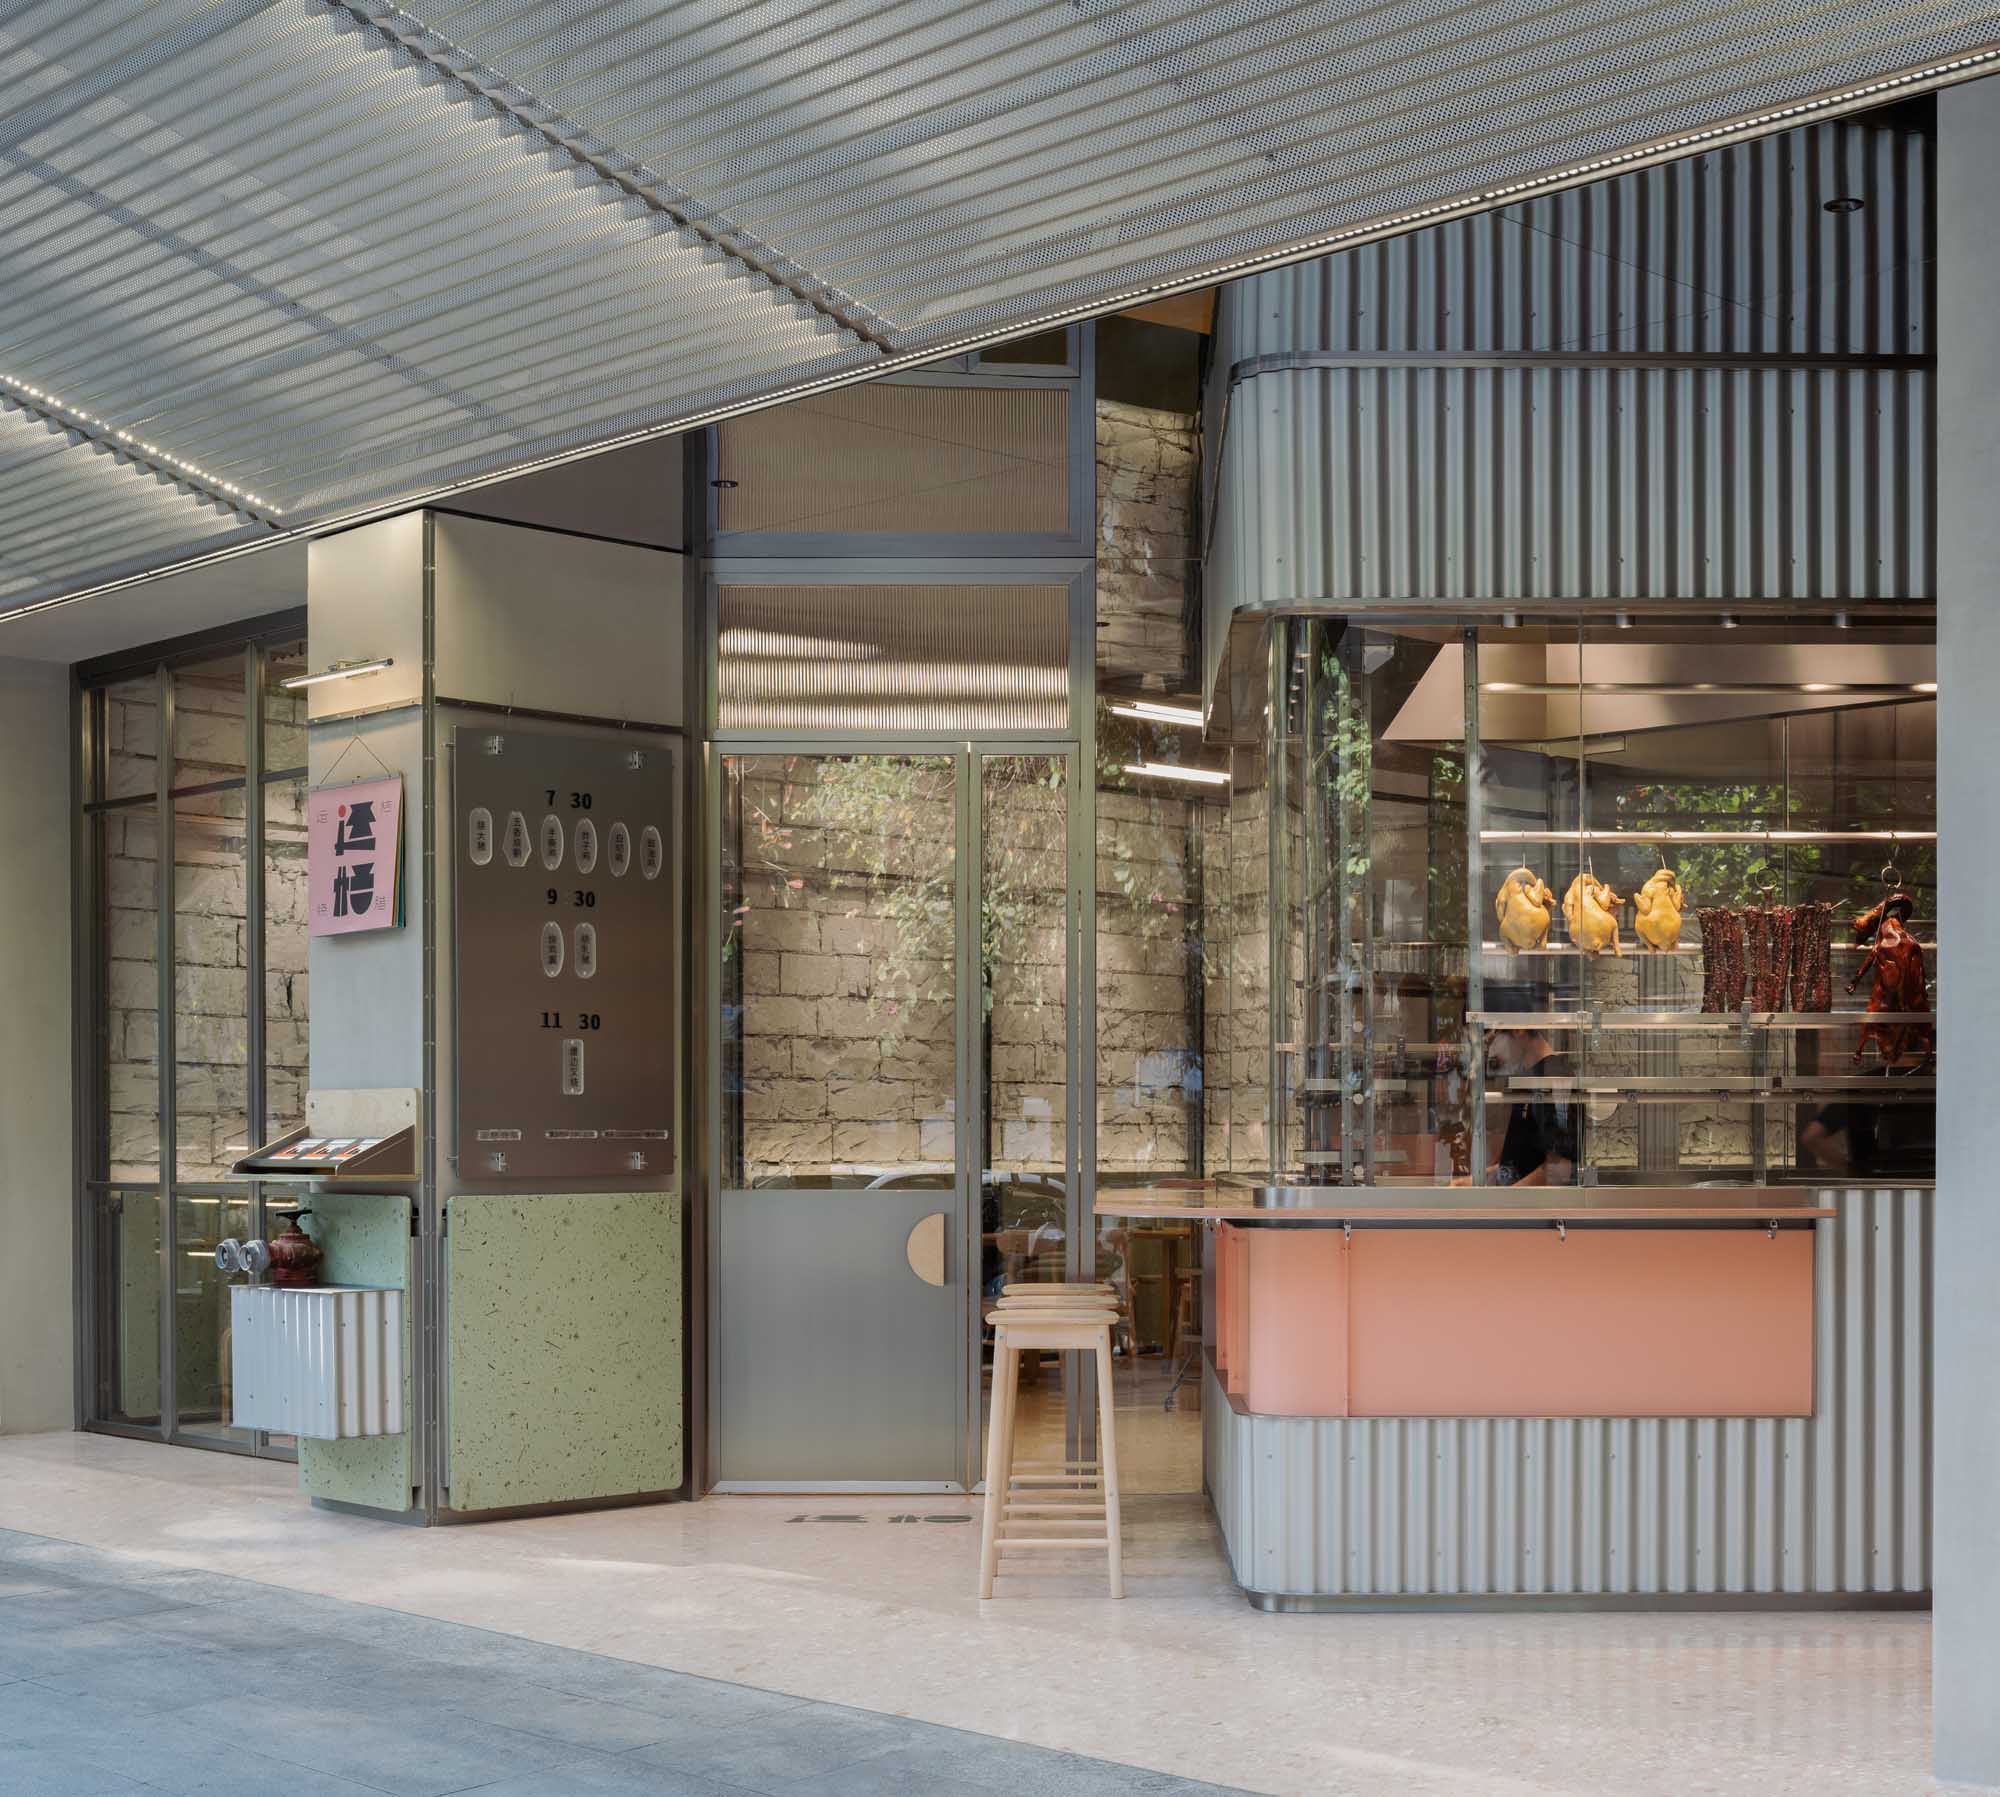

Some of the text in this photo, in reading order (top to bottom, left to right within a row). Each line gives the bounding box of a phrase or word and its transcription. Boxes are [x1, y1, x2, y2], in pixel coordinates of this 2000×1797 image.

[545, 790, 592, 809] 7 30
[547, 888, 595, 908] 9 30
[540, 1012, 600, 1030] 11 30
